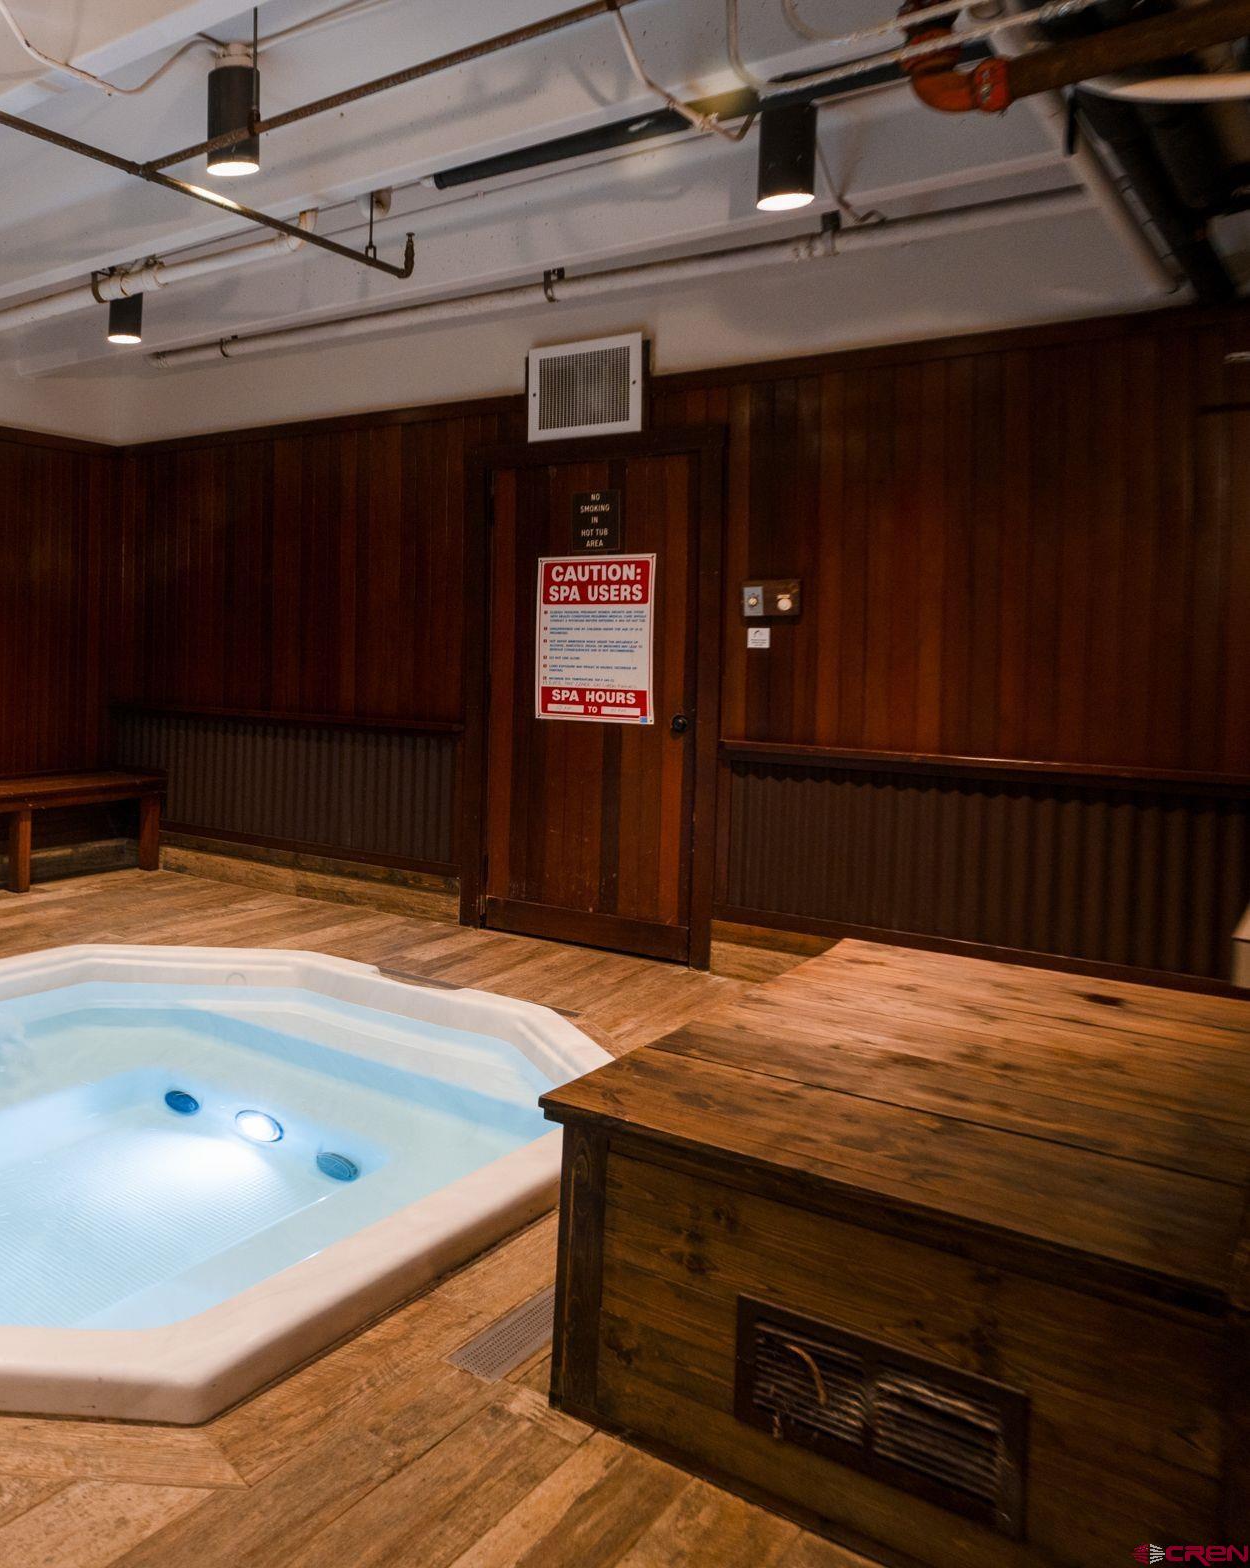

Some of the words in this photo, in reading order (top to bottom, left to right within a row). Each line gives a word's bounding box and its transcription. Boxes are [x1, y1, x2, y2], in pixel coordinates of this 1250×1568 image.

[590, 493, 600, 501] NO
[580, 504, 610, 513] SMOKING
[591, 516, 598, 524] IN
[581, 528, 594, 537] HOT
[595, 527, 608, 536] TUB
[586, 539, 604, 548] AREA
[551, 564, 642, 582] CAUTION:
[549, 585, 581, 602] SPA
[587, 584, 643, 602] USERS
[552, 689, 580, 702] SPA
[585, 690, 636, 704] HOURS
[588, 705, 598, 713] TO
